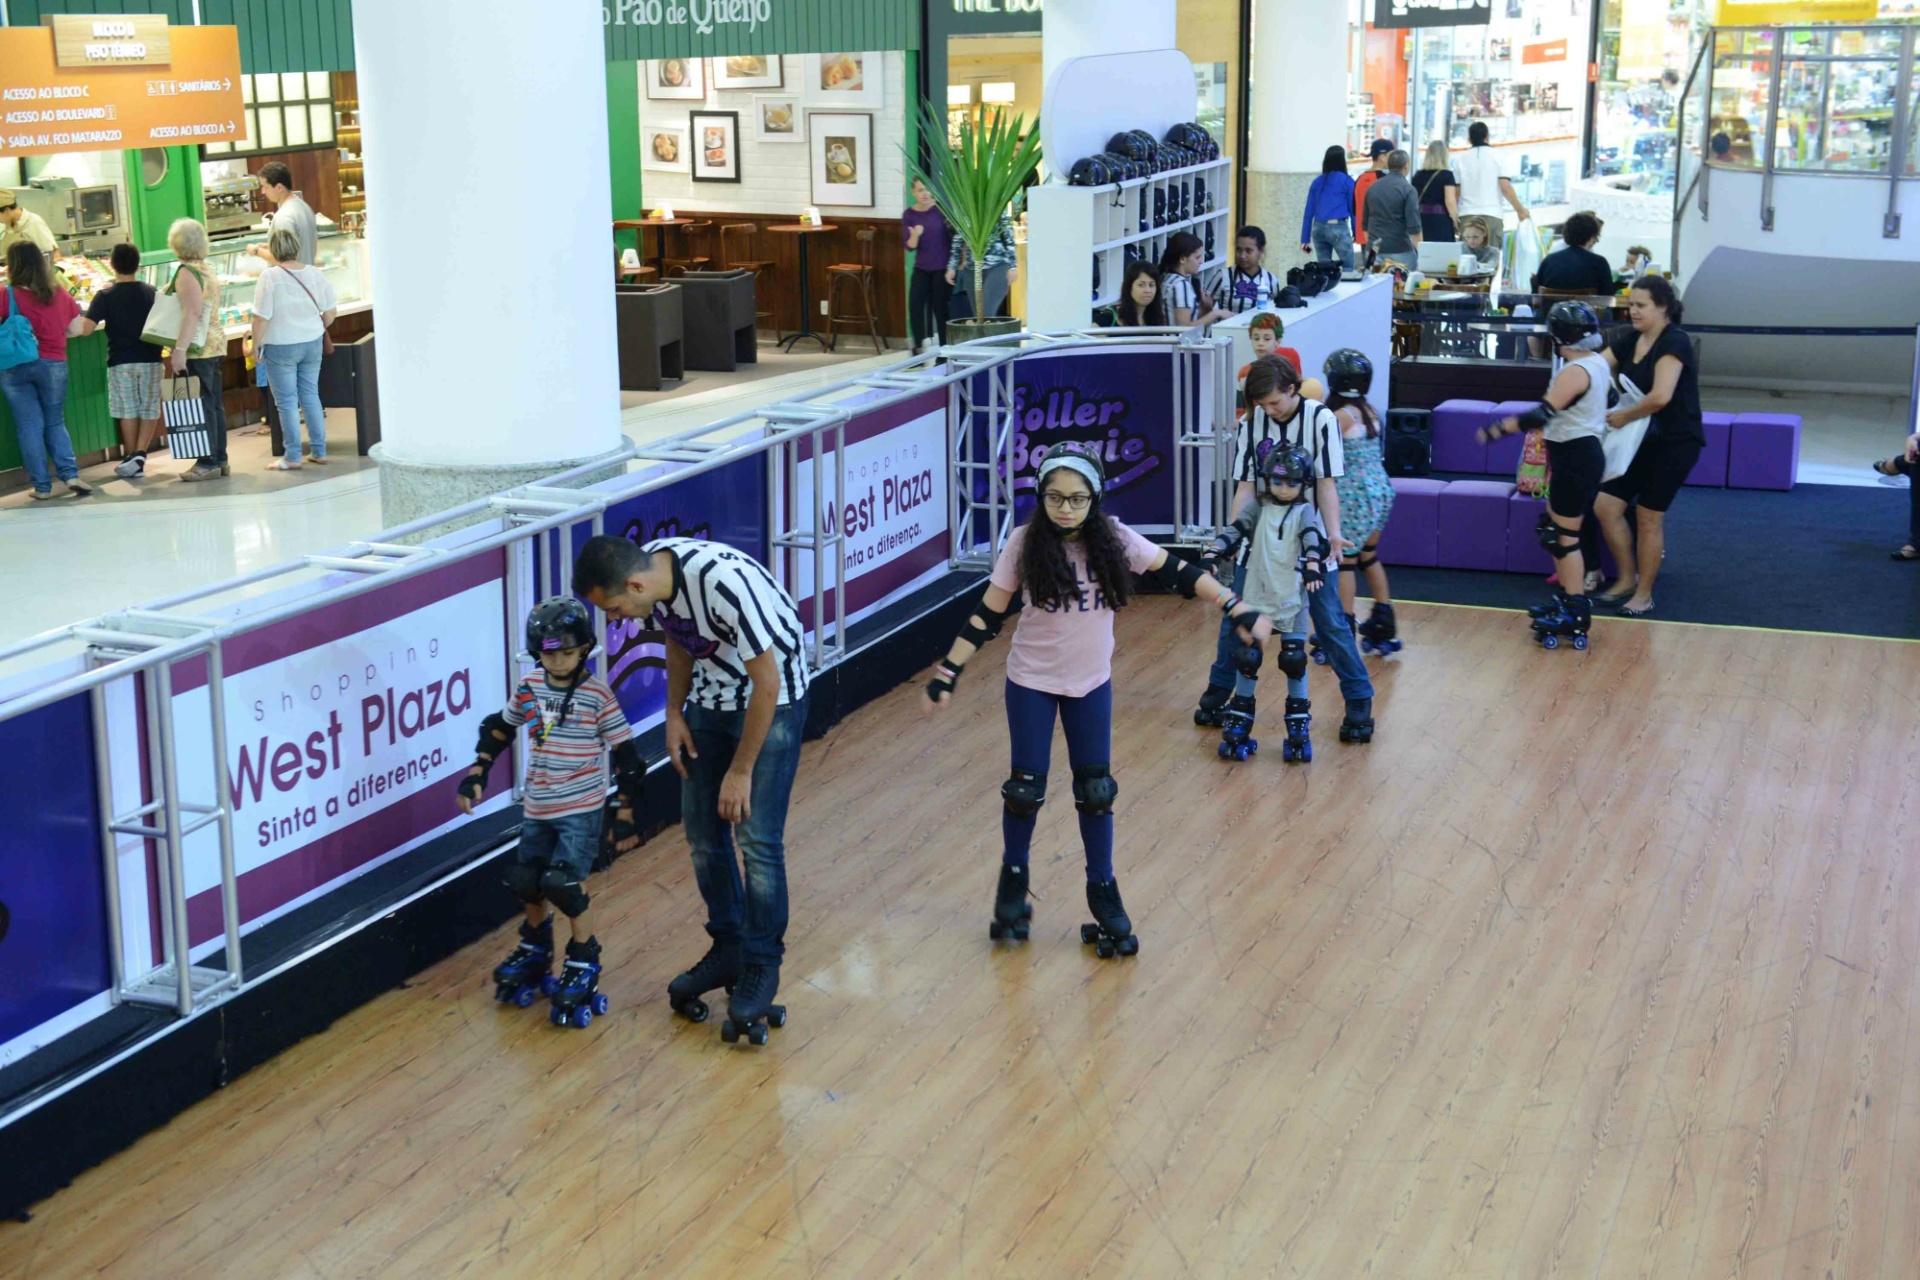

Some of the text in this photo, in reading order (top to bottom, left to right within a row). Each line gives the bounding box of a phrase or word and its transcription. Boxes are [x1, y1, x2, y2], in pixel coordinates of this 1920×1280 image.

[666, 0, 688, 25] de
[689, 0, 771, 34] Queijo
[3, 85, 90, 100] ACESSO AO BLOCO C
[178, 78, 222, 93] SANITÁRIOS
[6, 107, 106, 123] ACESSO AO BOULEVARD
[149, 123, 226, 138] ACESSO AO BLOCO A
[8, 130, 122, 148] SAÍDA AV. FCO MATARAZZO
[848, 444, 918, 483] hopping
[998, 428, 1146, 477] Boie
[883, 468, 932, 521] Plaza
[843, 522, 922, 571] inta a diferença.
[253, 637, 439, 722] Shopping
[227, 667, 471, 812] West Plaza
[257, 747, 448, 847] Sinta a diferença.
